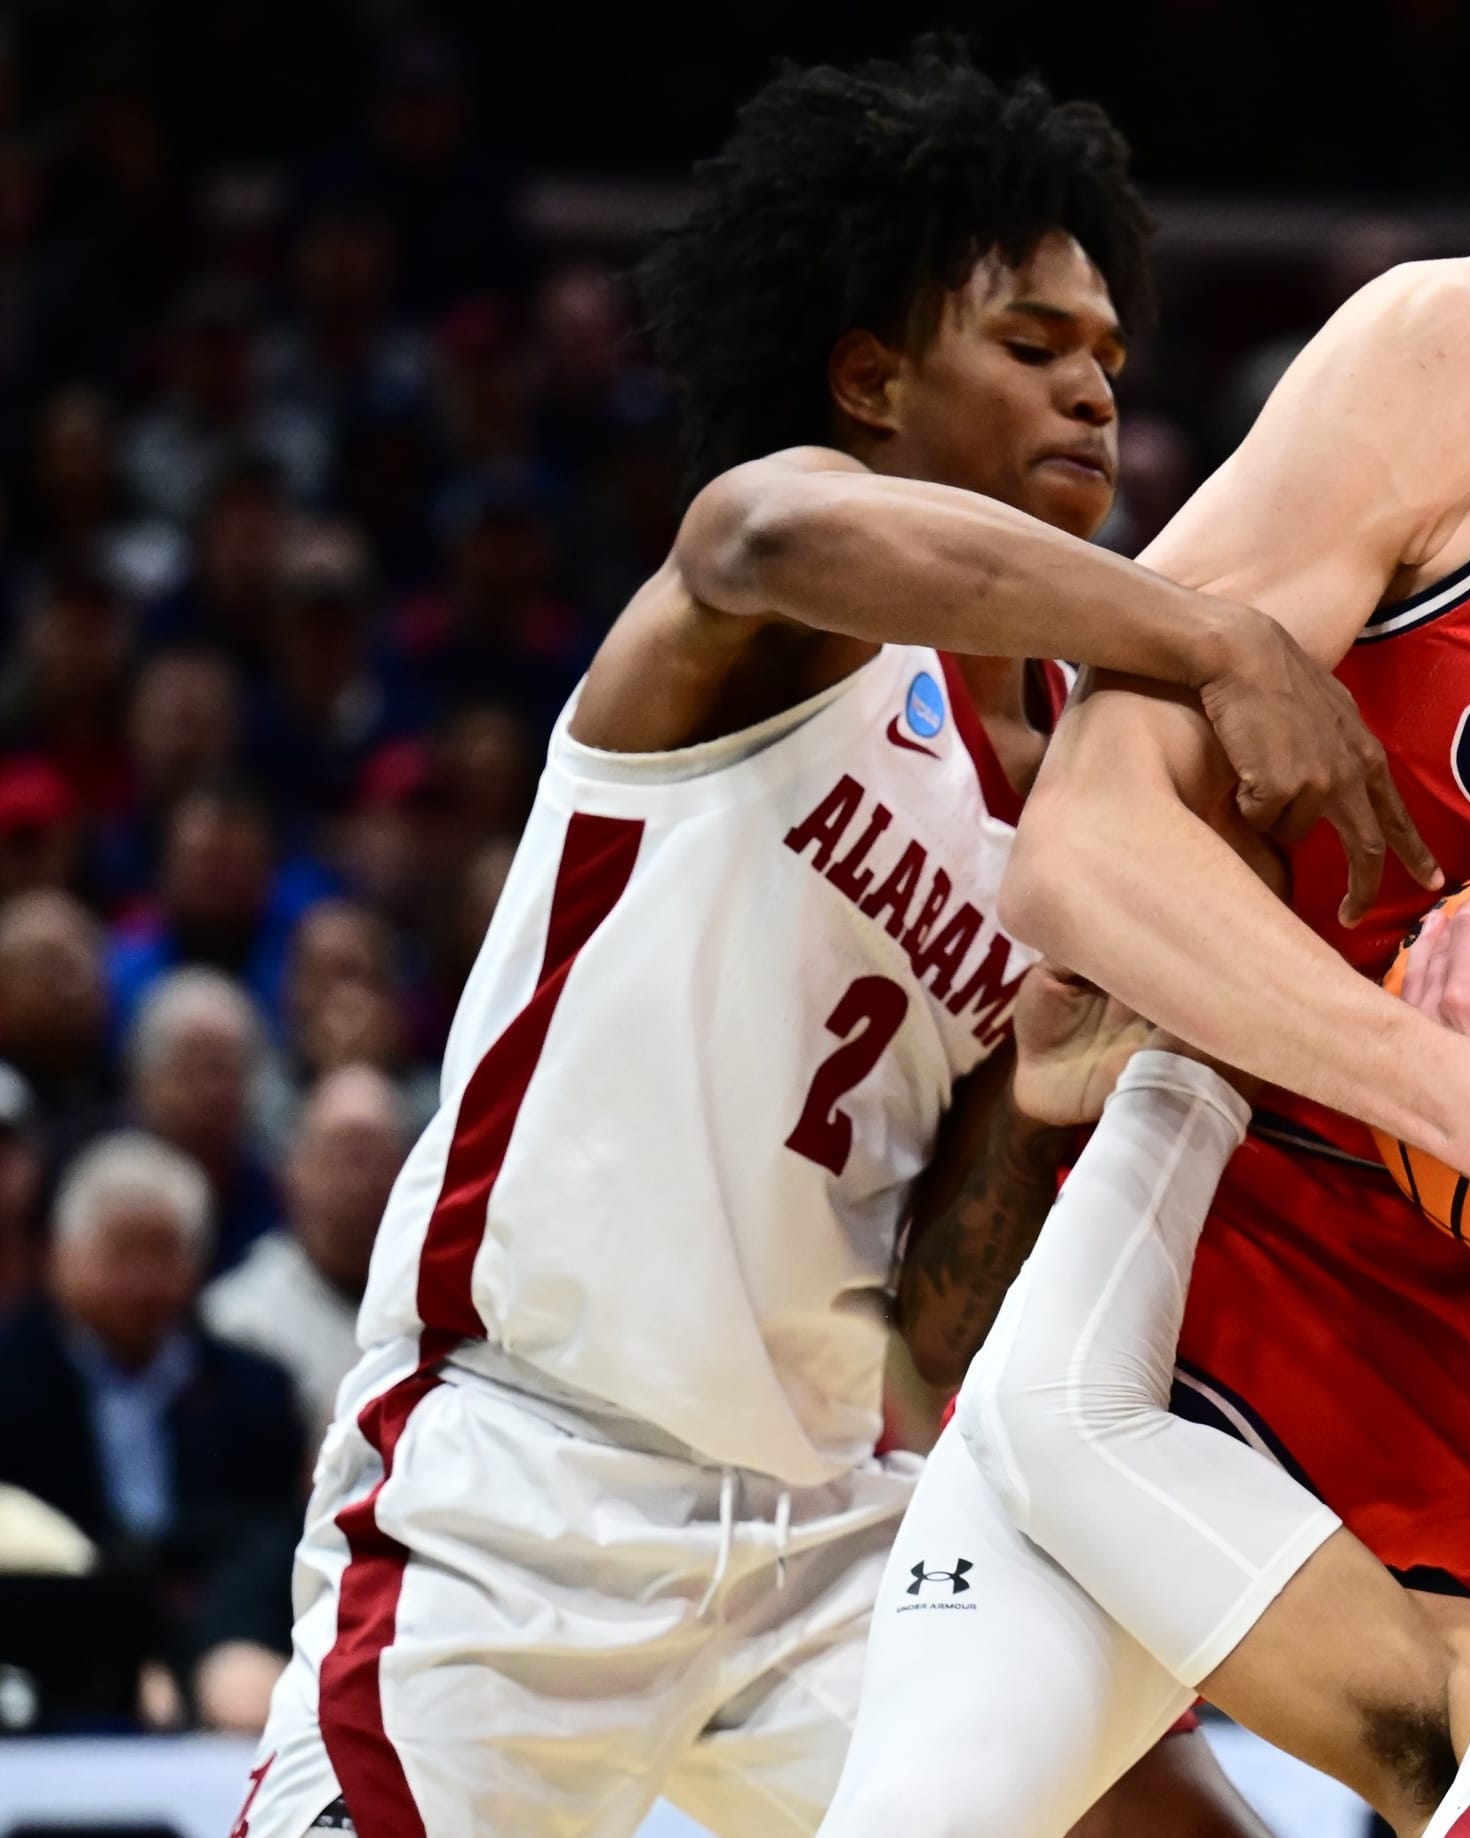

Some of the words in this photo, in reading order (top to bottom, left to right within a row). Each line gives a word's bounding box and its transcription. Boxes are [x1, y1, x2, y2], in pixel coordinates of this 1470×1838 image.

[783, 773, 1033, 1048] ALABAM
[784, 974, 909, 1177] 2
[897, 1602, 927, 1613] UNDER
[930, 1602, 976, 1610] ARMOUR
